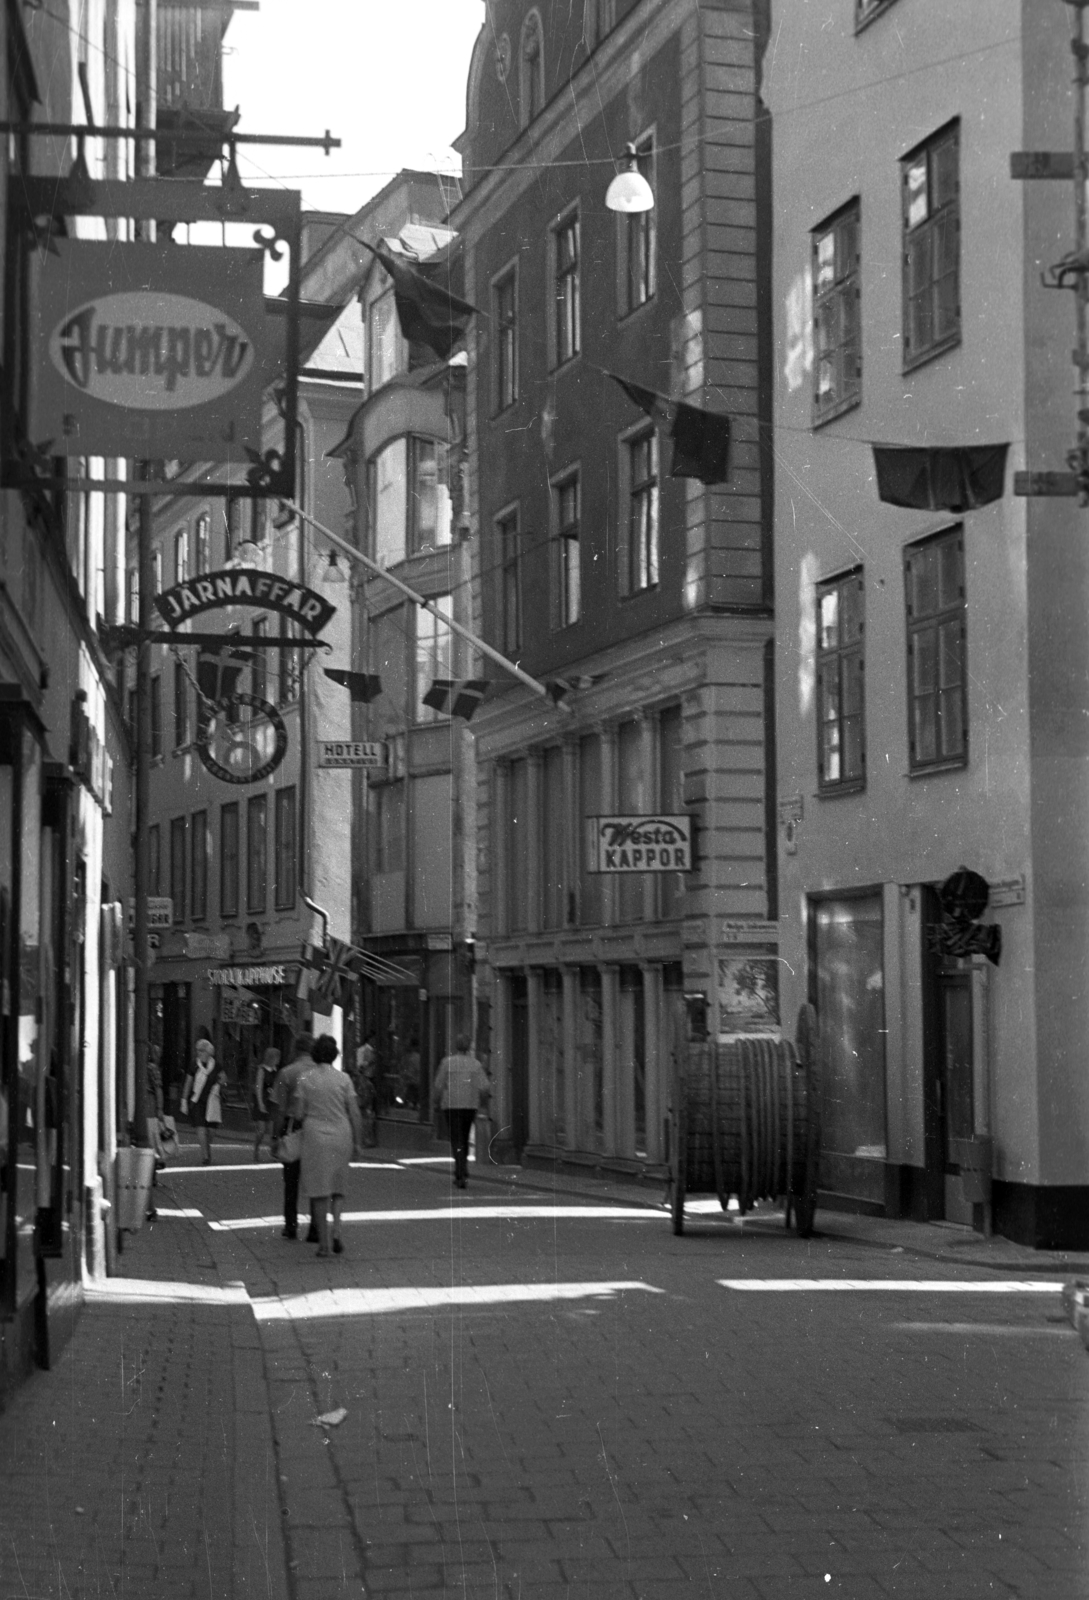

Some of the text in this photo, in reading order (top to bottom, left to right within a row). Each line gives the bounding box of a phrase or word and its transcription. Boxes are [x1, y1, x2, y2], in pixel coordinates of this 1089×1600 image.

[59, 305, 249, 392] Jumper
[166, 575, 323, 622] JÄRNAFFÄR
[324, 744, 378, 756] HOTELL
[601, 819, 687, 847] Westa
[605, 848, 686, 868] KAPPOR
